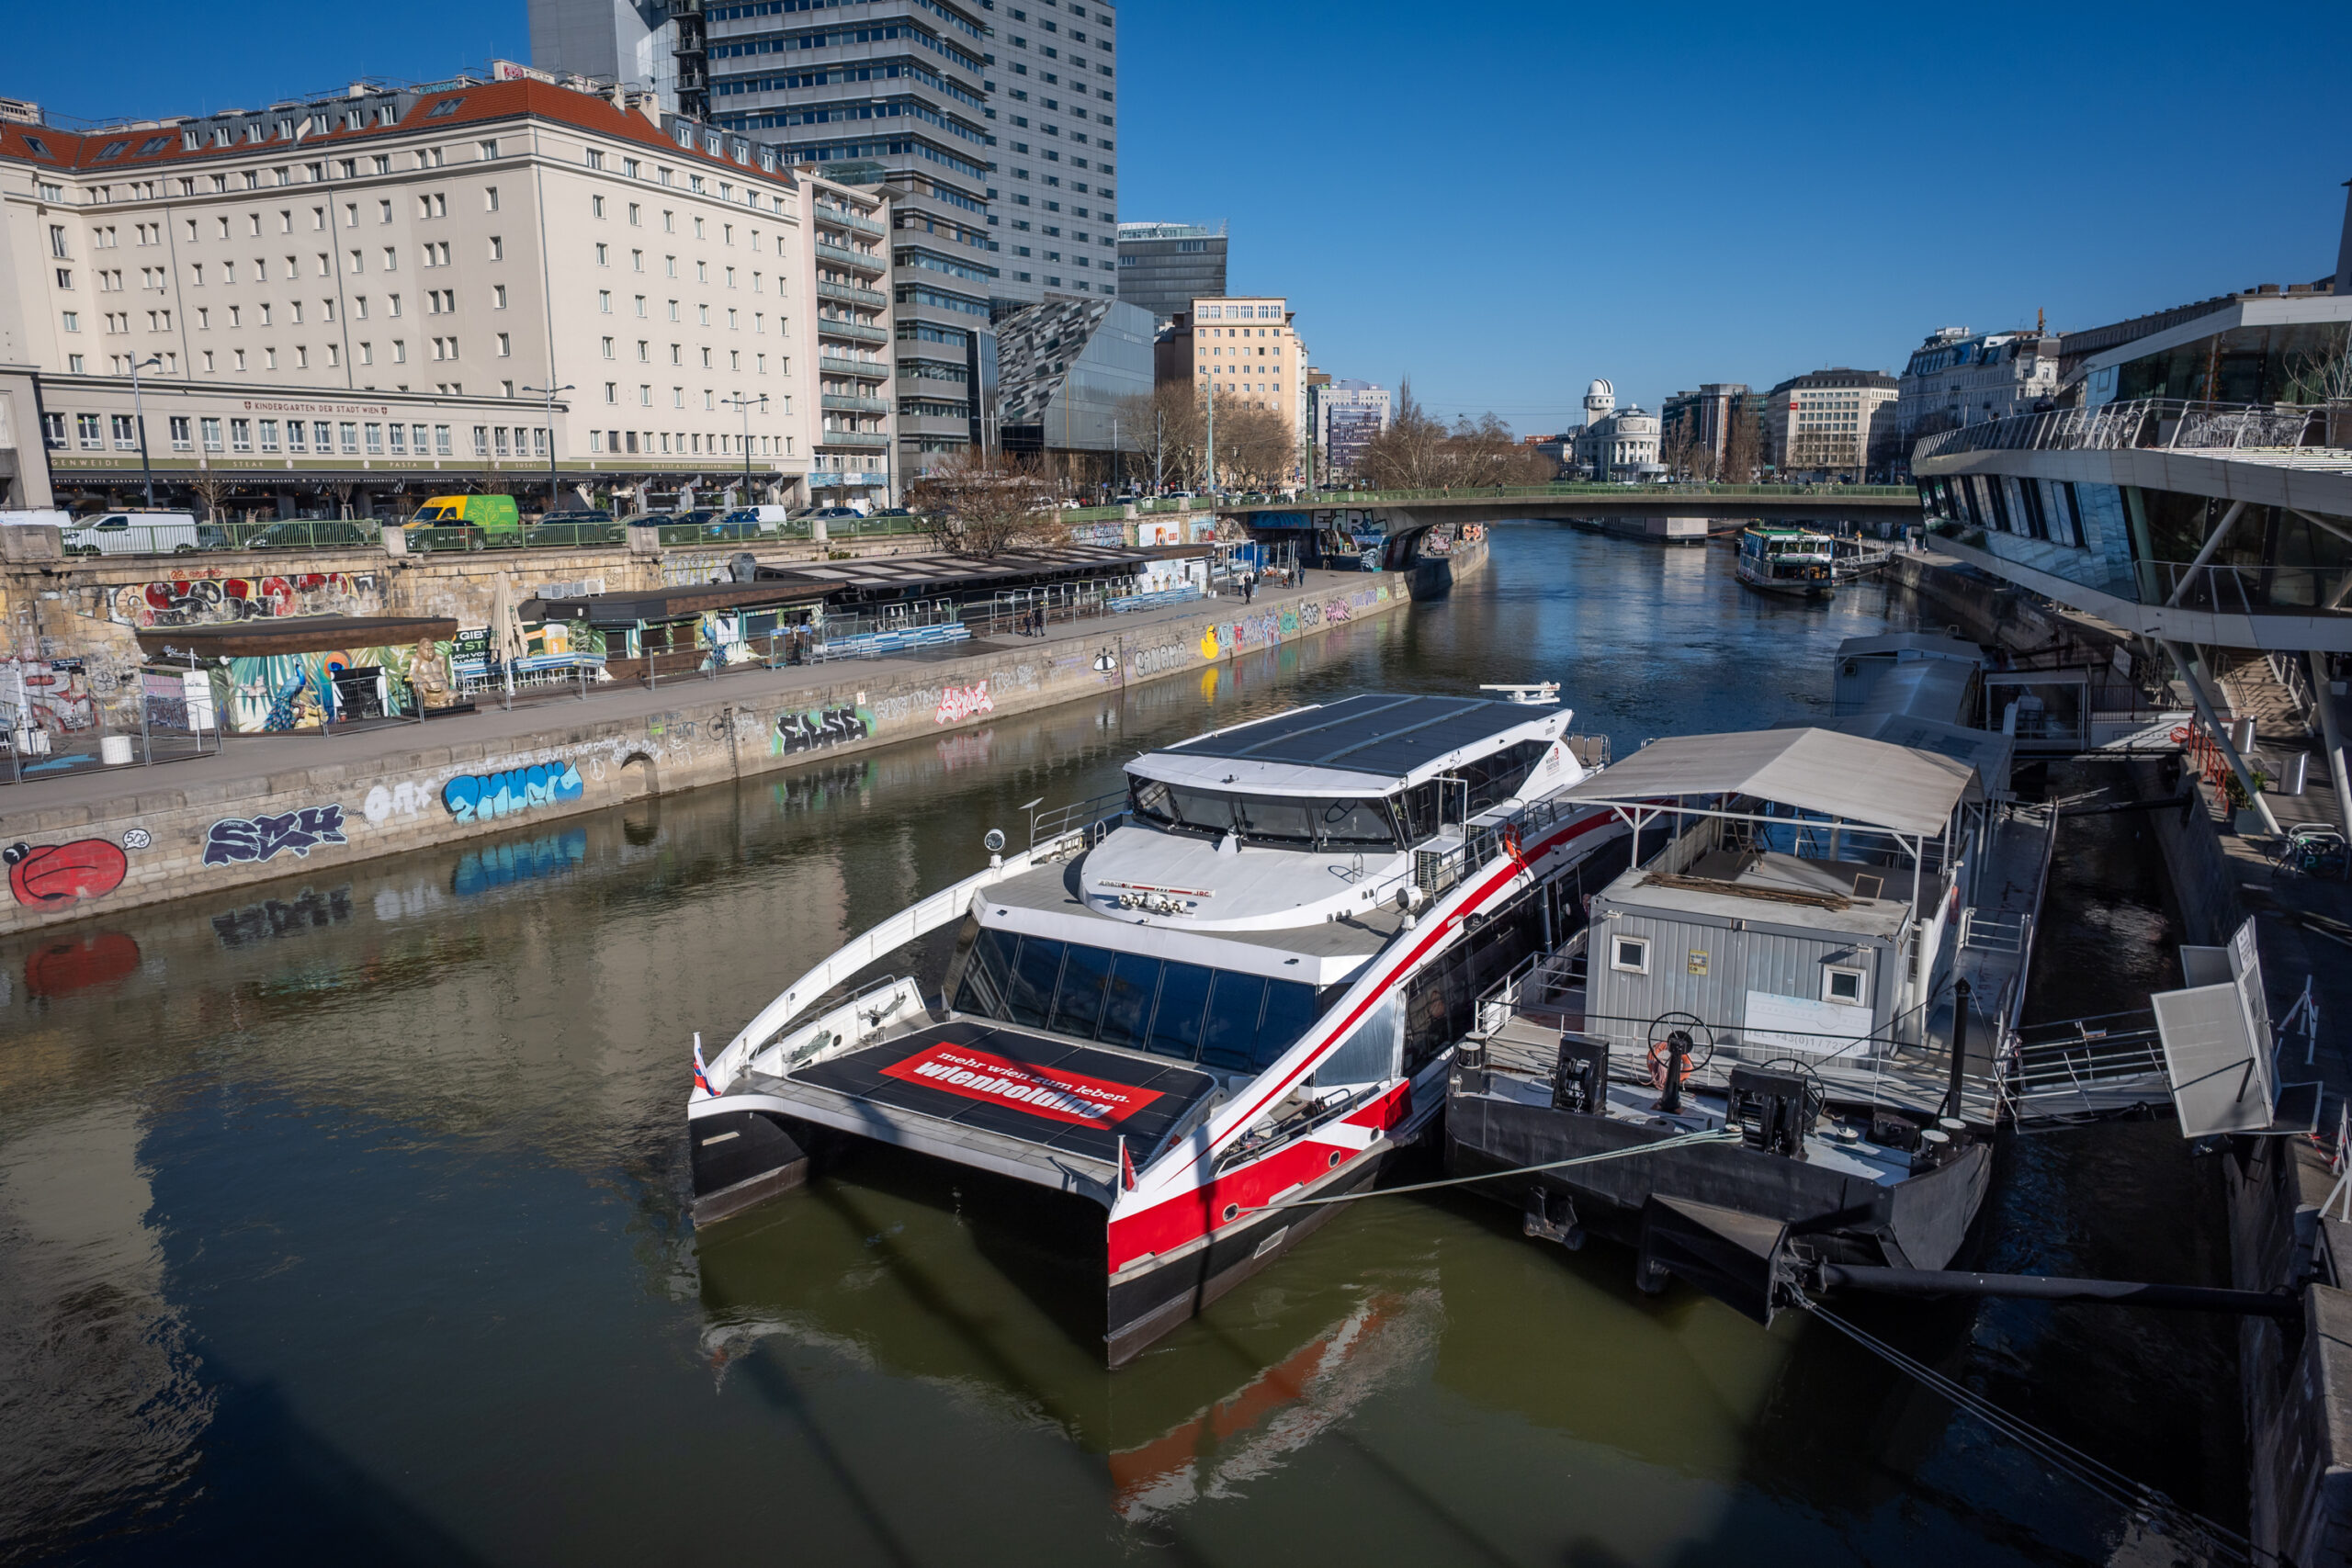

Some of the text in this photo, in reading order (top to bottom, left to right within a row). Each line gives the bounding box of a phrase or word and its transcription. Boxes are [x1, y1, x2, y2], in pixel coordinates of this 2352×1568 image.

[254, 401, 315, 412] KINDERGARTEN
[319, 404, 333, 412] DER
[336, 405, 359, 413] STADT
[126, 831, 147, 846] 508
[936, 1052, 1130, 1103] mehr wien zum leben.
